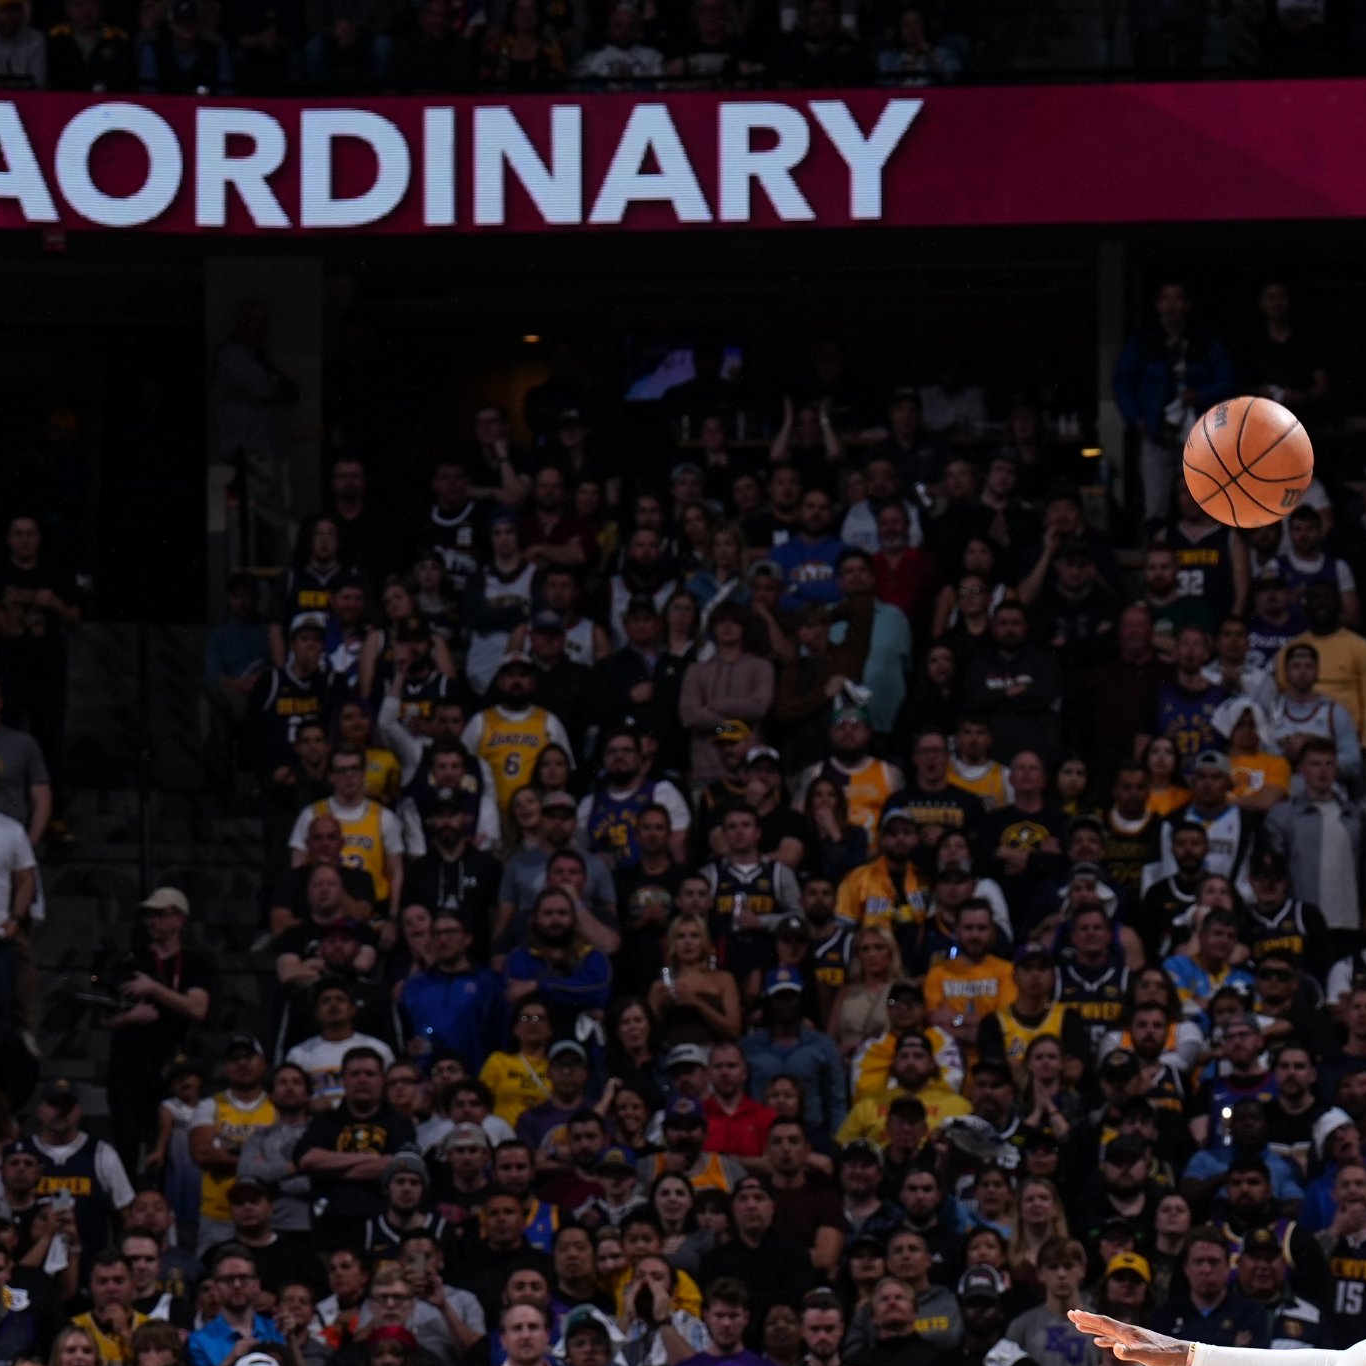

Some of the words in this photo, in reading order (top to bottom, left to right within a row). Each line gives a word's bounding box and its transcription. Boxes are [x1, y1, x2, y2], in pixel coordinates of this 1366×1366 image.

[1176, 569, 1206, 597] 32
[502, 751, 522, 779] 6
[938, 978, 997, 999] NUGGETS
[1335, 1281, 1365, 1317] 15
